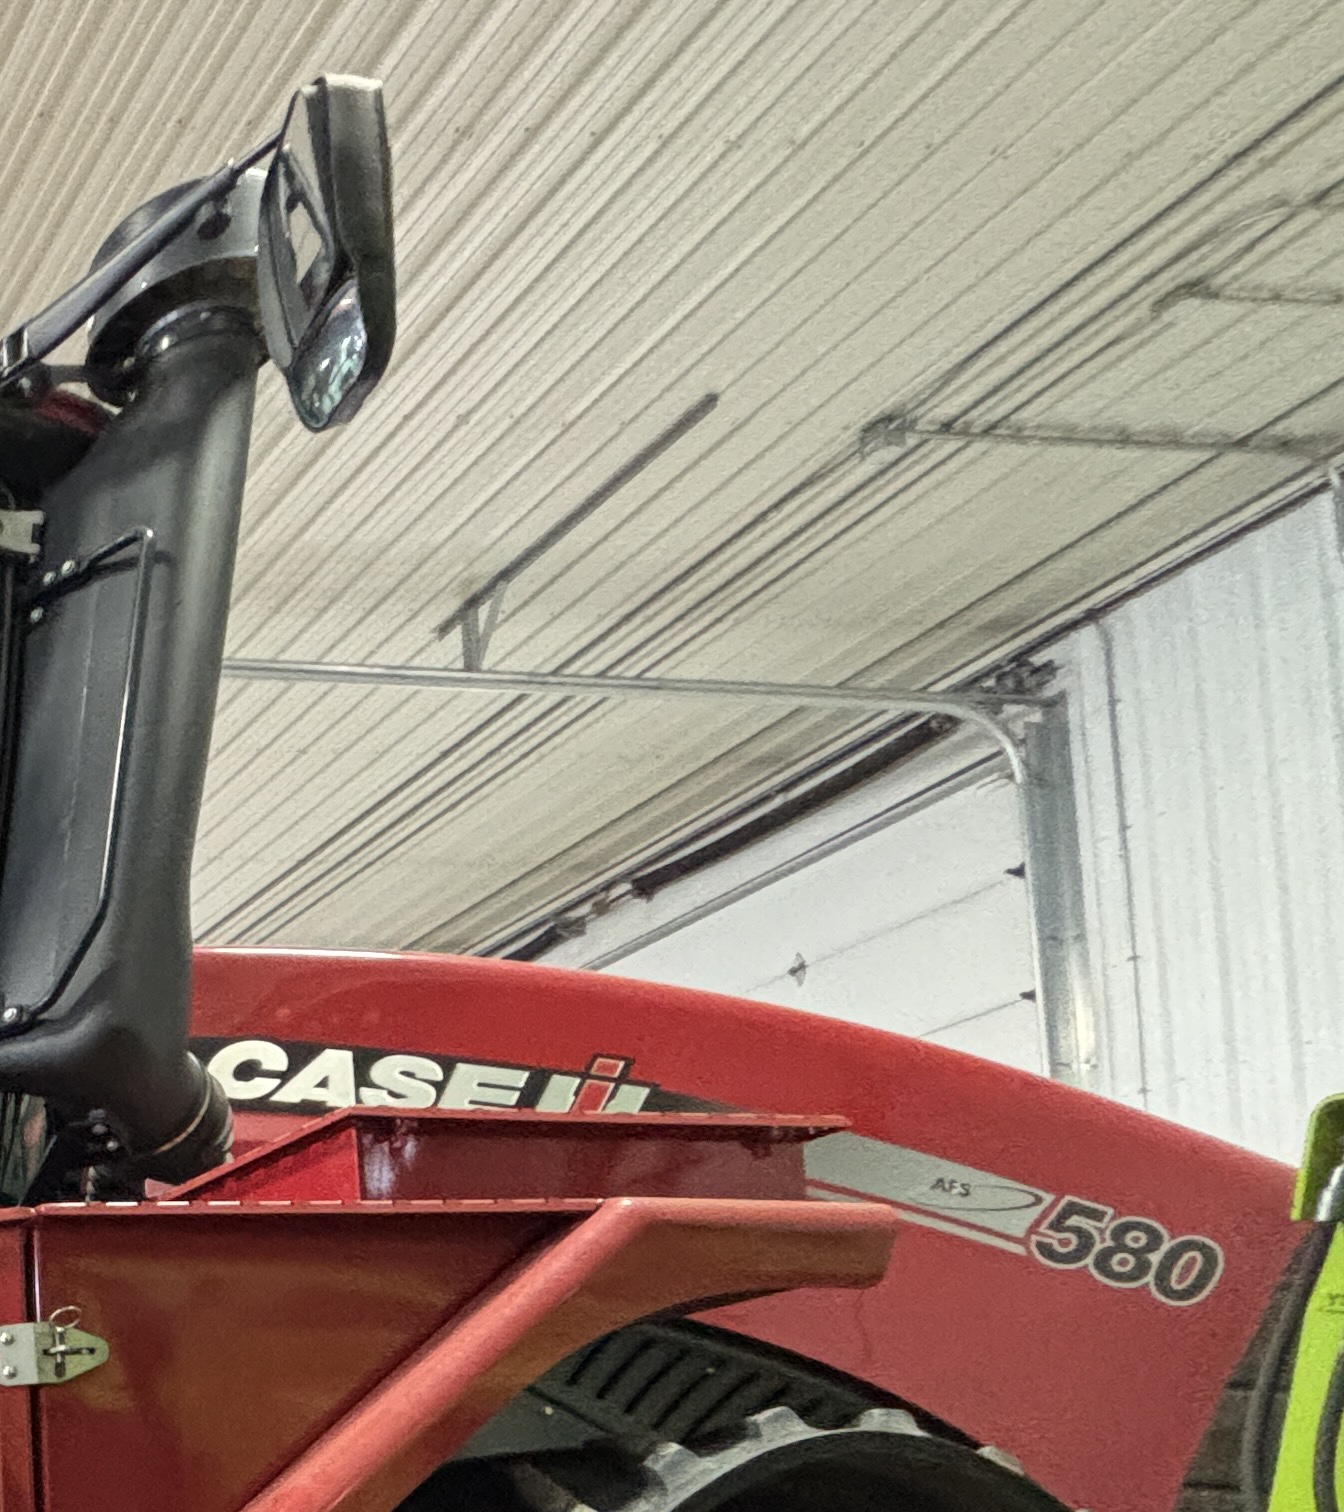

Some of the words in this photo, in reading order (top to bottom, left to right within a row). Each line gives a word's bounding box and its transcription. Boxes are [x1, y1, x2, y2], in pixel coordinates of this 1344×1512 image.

[207, 1039, 531, 1109] CASE
[929, 1176, 972, 1198] AFS
[1029, 1194, 1225, 1307] 580
